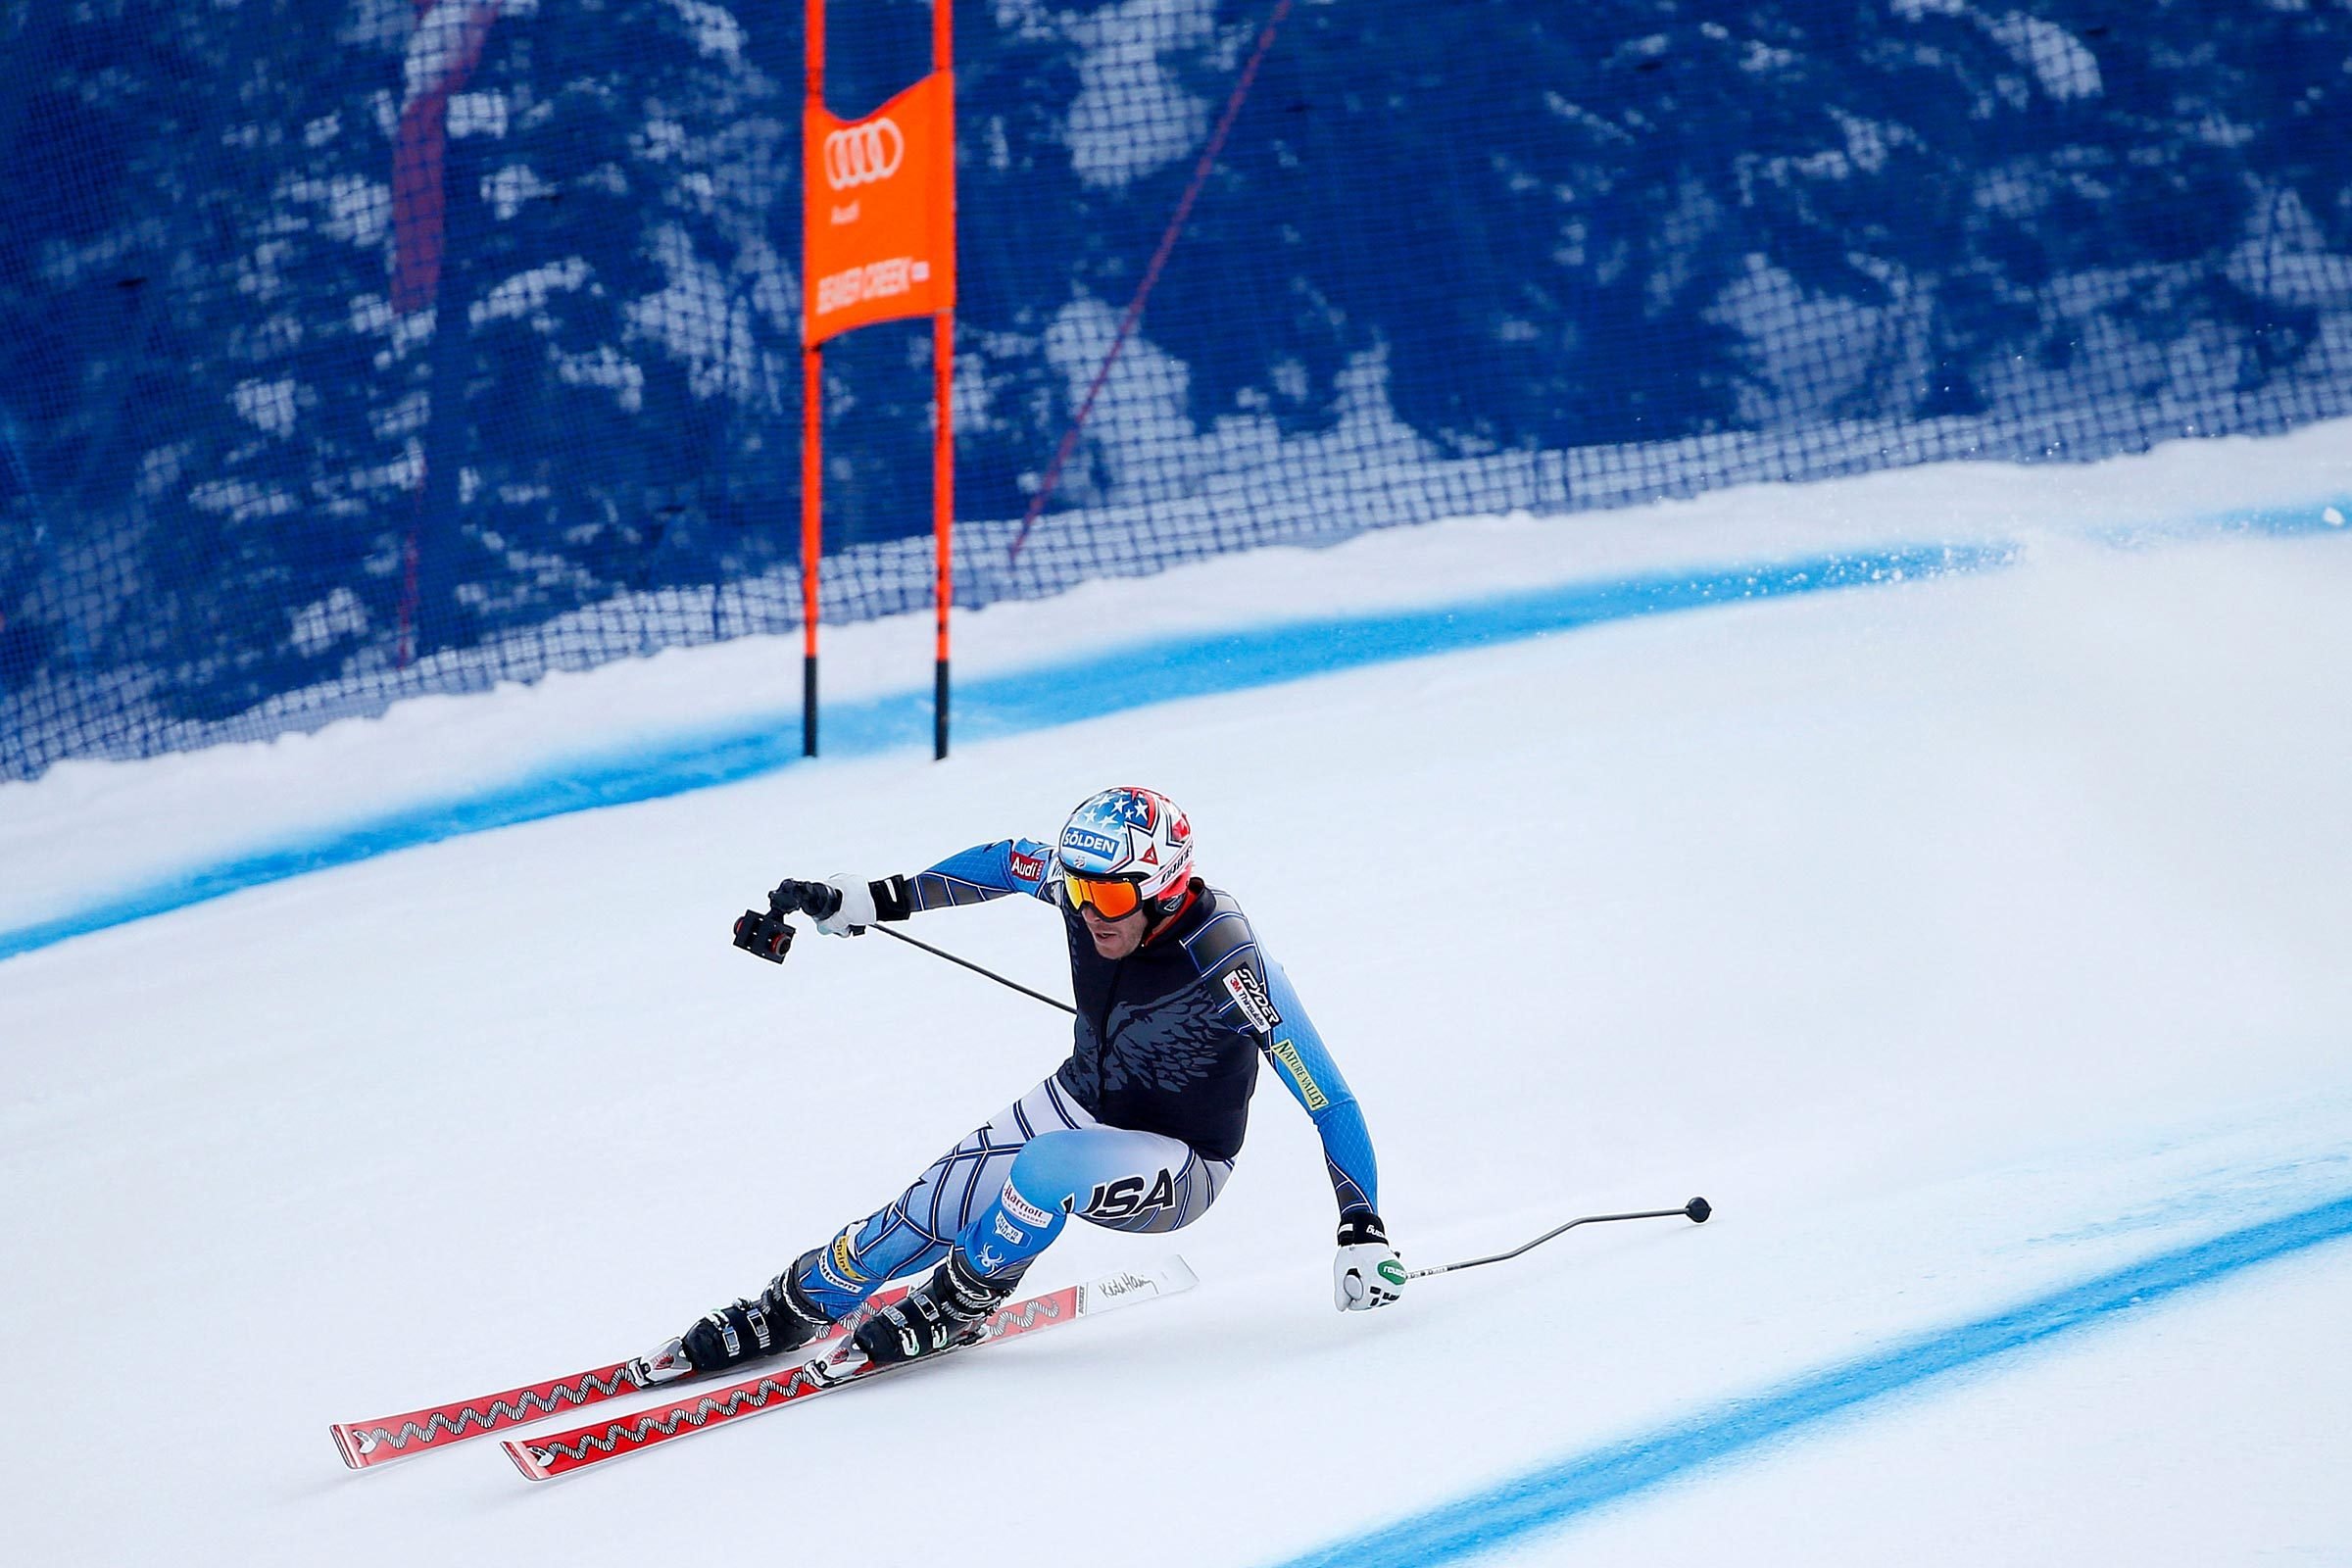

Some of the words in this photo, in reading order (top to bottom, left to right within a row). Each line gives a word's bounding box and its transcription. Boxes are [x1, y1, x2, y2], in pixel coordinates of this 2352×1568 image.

[1063, 828, 1115, 855] SÖLDEN
[1011, 857, 1039, 878] Audi
[1230, 977, 1243, 993] 3M
[1237, 968, 1280, 1023] SPYDER
[1274, 1041, 1305, 1077] NATURE
[1301, 1074, 1328, 1109] VALLEY
